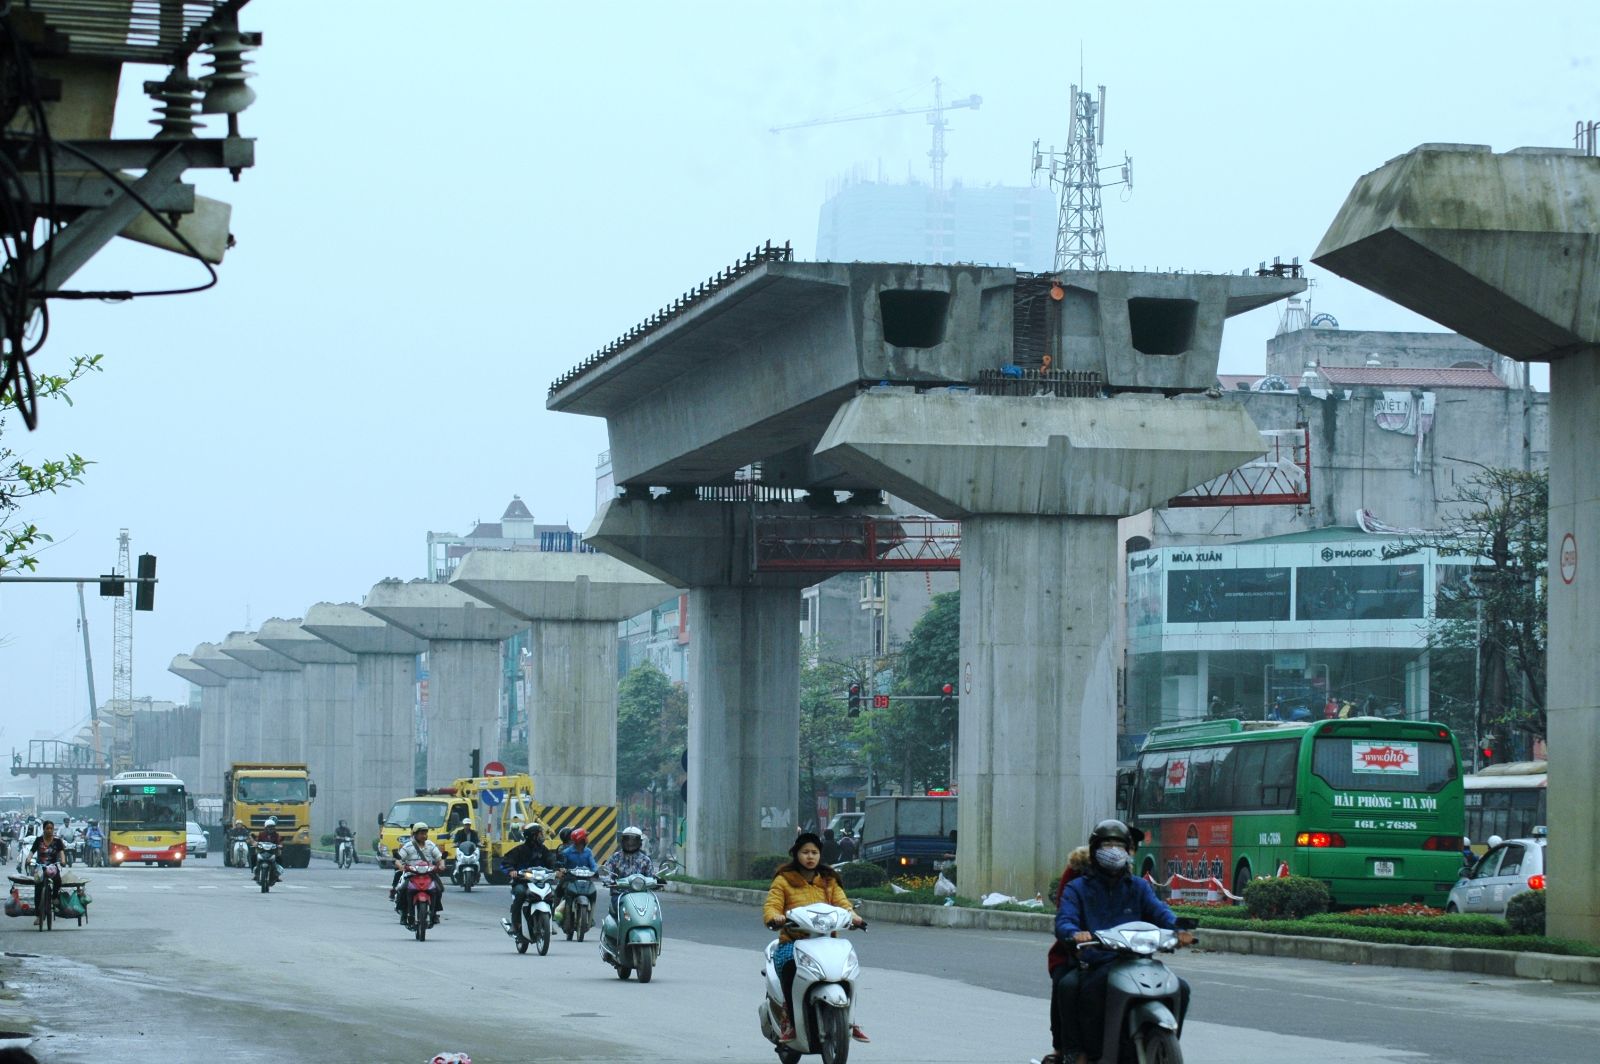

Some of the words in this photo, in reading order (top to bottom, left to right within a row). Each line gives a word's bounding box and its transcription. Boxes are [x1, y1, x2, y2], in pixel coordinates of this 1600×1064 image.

[1172, 551, 1193, 563] MÙA
[1196, 550, 1223, 562] XUÂN
[1335, 549, 1373, 558] PIAGGIO
[1358, 794, 1392, 808] PHÒNG
[1403, 795, 1418, 809] HÀ
[1420, 795, 1437, 813] NỘI
[1386, 821, 1417, 830] 7638
